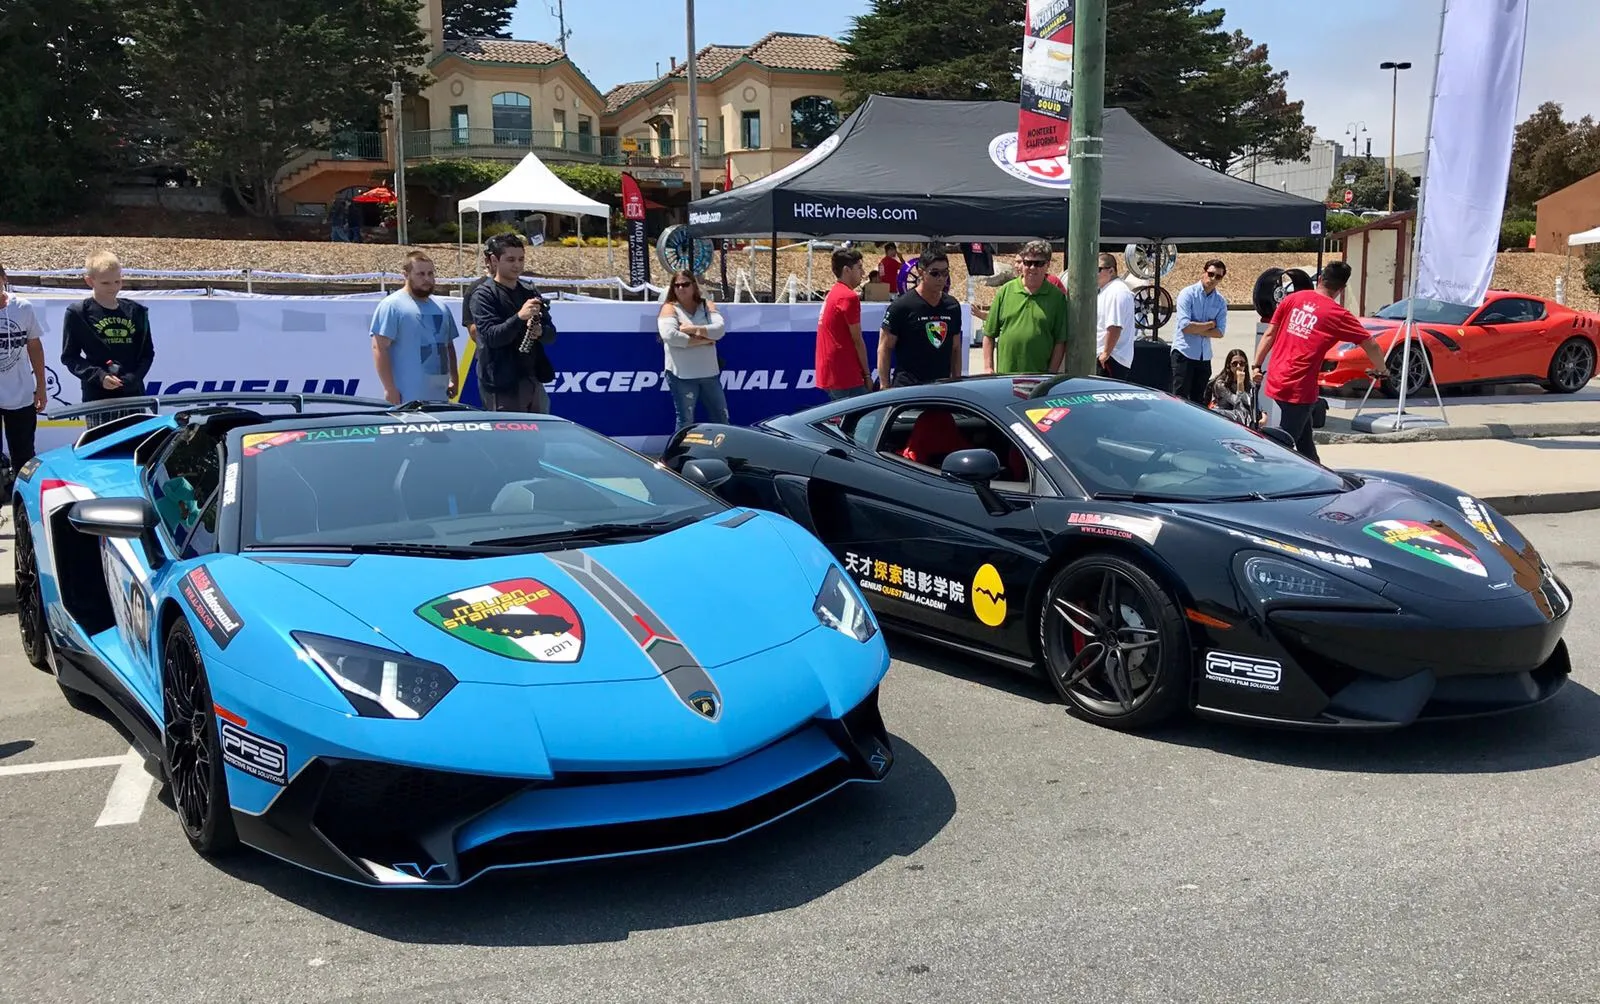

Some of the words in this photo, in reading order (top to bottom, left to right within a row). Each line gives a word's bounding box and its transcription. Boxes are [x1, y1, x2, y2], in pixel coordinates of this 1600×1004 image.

[1037, 99, 1062, 112] SQUID
[1026, 136, 1059, 148] CALIFORNIA
[794, 203, 917, 220] HREwheels.com
[635, 221, 644, 243] ROW
[1287, 322, 1312, 335] STAFF
[1290, 308, 1318, 330] EOCR
[146, 379, 360, 402] ICHELIN
[845, 552, 965, 604] 天才探索电影学院
[860, 579, 882, 592] GENIUS
[882, 585, 902, 598] QUEST
[902, 592, 915, 602] FILM
[915, 596, 947, 611] ACADEMY
[200, 587, 240, 632] Autosound
[544, 640, 573, 657] 2017
[1207, 655, 1280, 682] PFS
[1205, 673, 1235, 684] PROTECTIVE
[1249, 682, 1280, 691] SOLUTIONS
[223, 729, 284, 771] PFS
[223, 753, 246, 770] PROTECTIVE
[246, 764, 257, 775] FILM
[257, 769, 285, 784] SOLUTIONS
